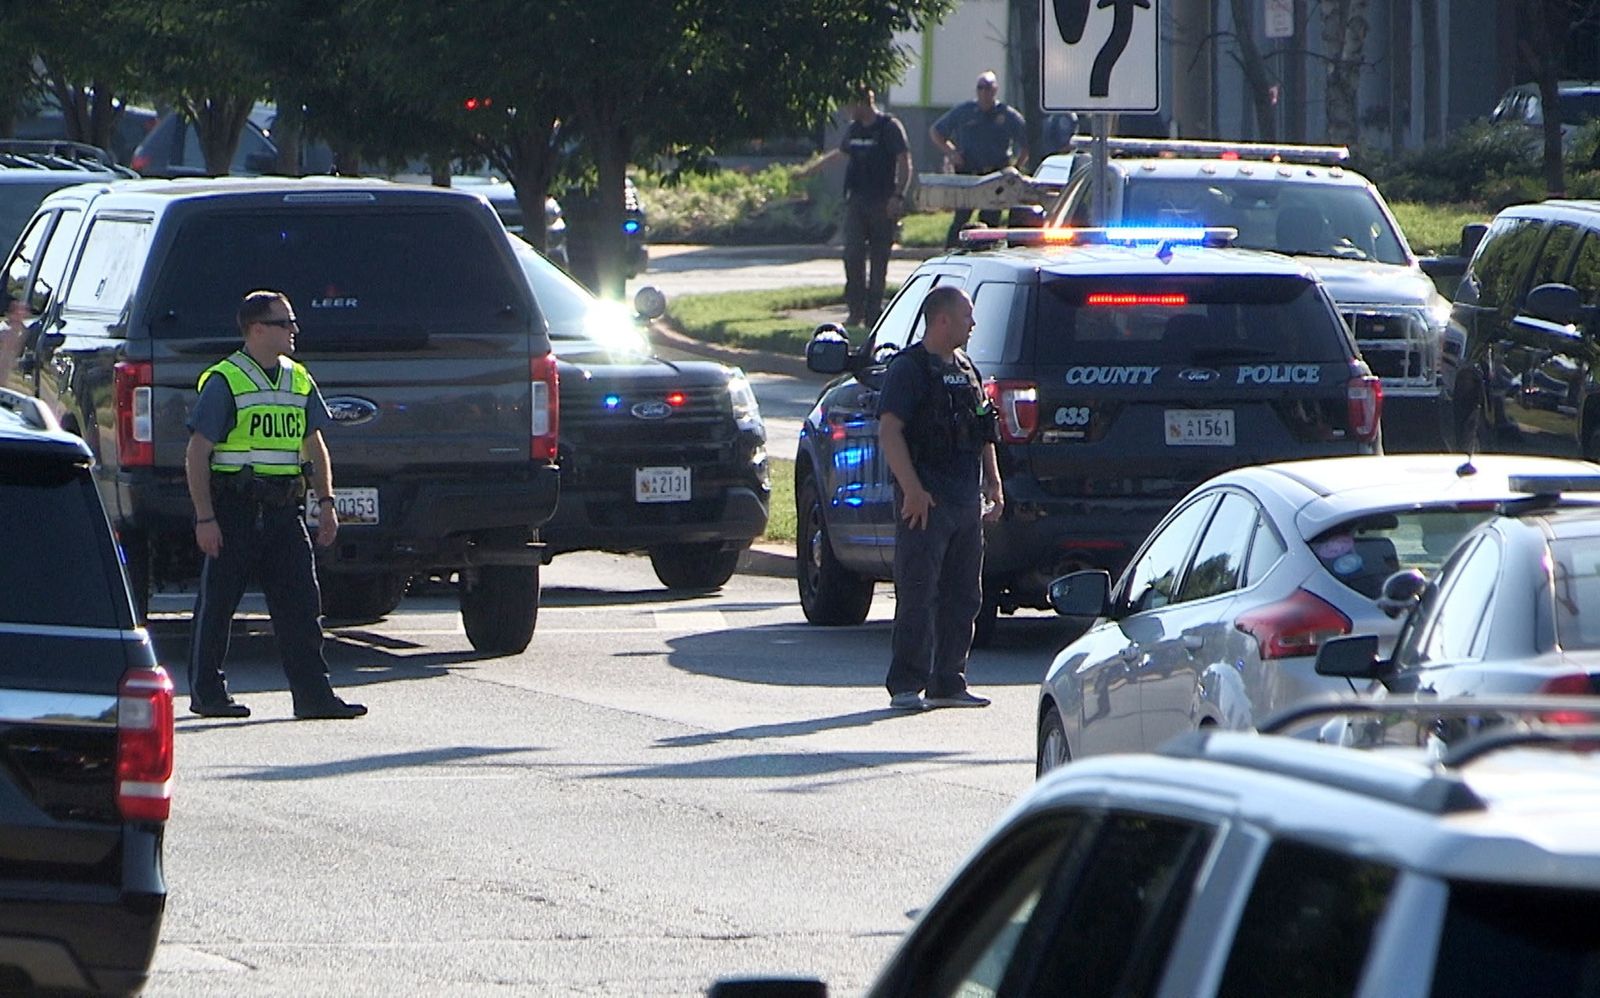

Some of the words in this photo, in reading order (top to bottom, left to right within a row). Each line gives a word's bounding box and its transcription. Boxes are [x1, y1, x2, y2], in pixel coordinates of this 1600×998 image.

[311, 297, 359, 308] LEER
[1065, 365, 1162, 385] COUNTY
[1236, 364, 1321, 384] POLICE
[249, 412, 302, 438] POLICE
[1055, 406, 1090, 425] 633
[1197, 419, 1230, 437] 1561
[660, 475, 687, 494] 2131
[310, 497, 376, 519] 20353
